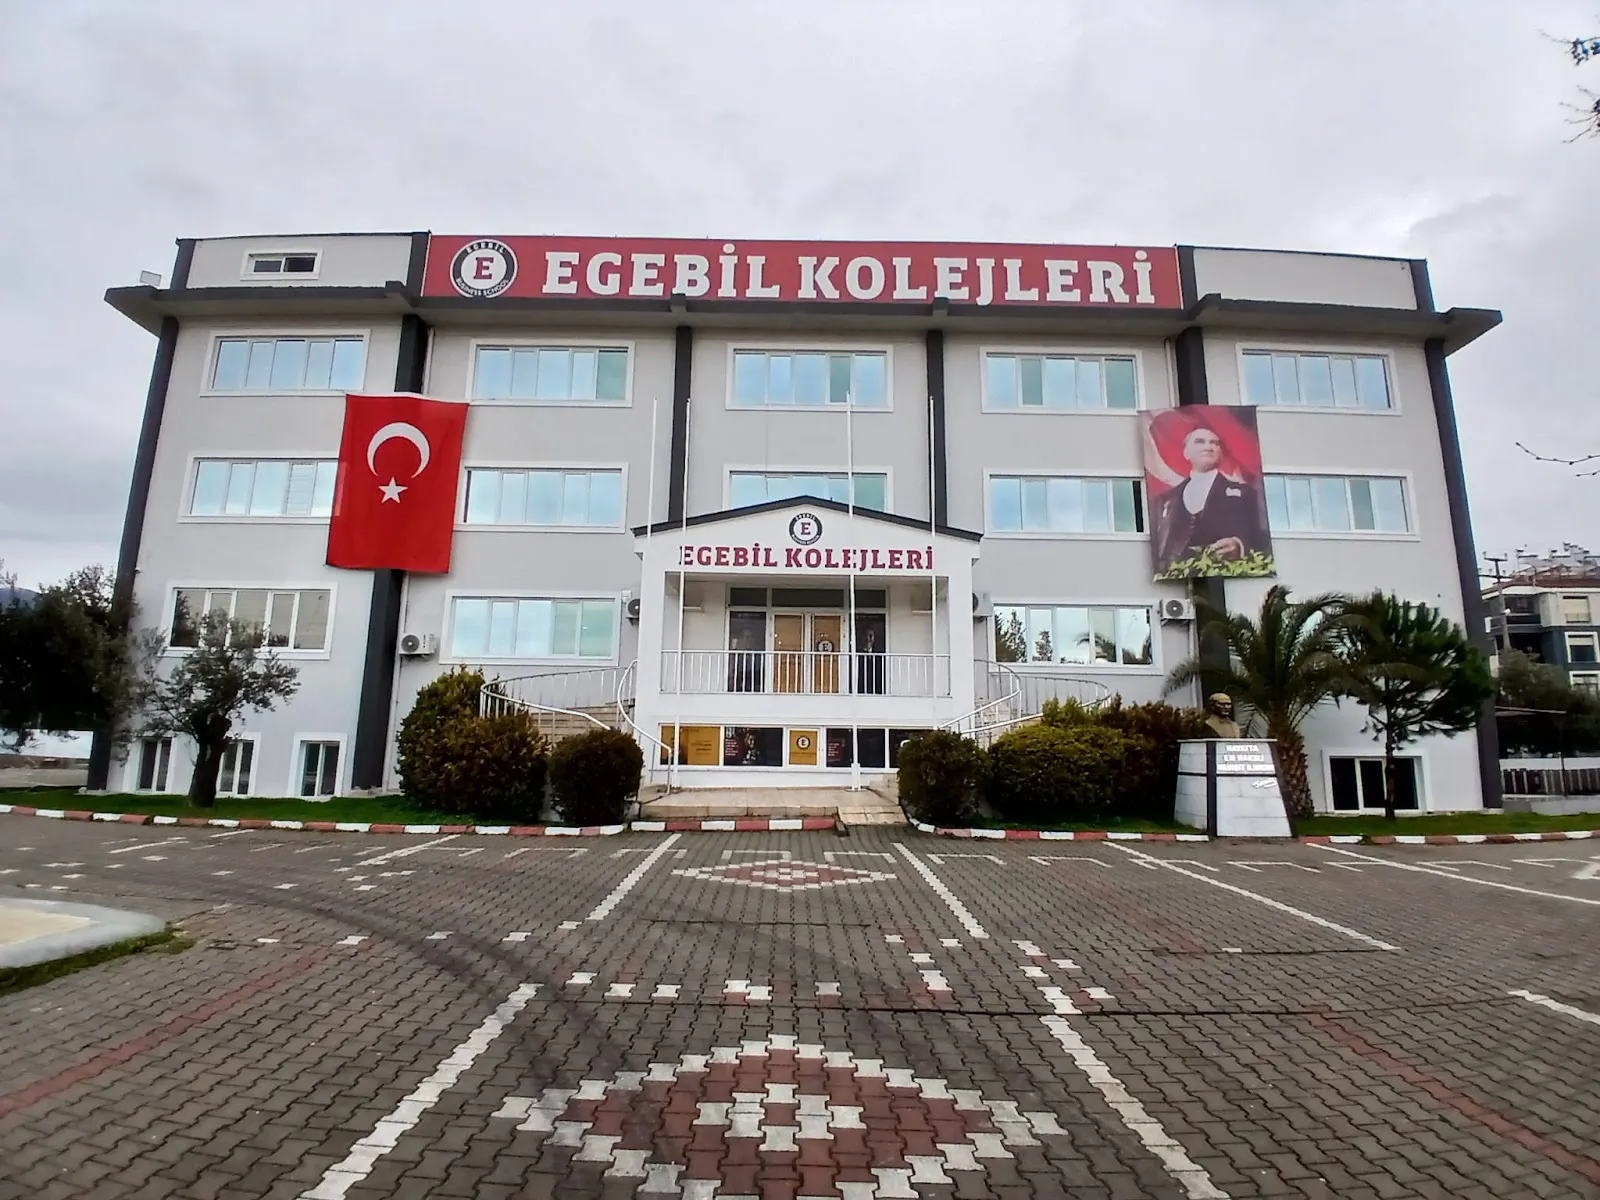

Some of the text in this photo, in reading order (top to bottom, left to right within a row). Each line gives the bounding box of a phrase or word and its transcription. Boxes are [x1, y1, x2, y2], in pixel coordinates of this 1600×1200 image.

[466, 242, 504, 253] EGEBİL
[473, 257, 493, 279] E
[542, 243, 1155, 306] EGEBİL KOLEJLERİ
[801, 522, 811, 535] E
[679, 543, 933, 571] EGEBİL KOLEJLERİ
